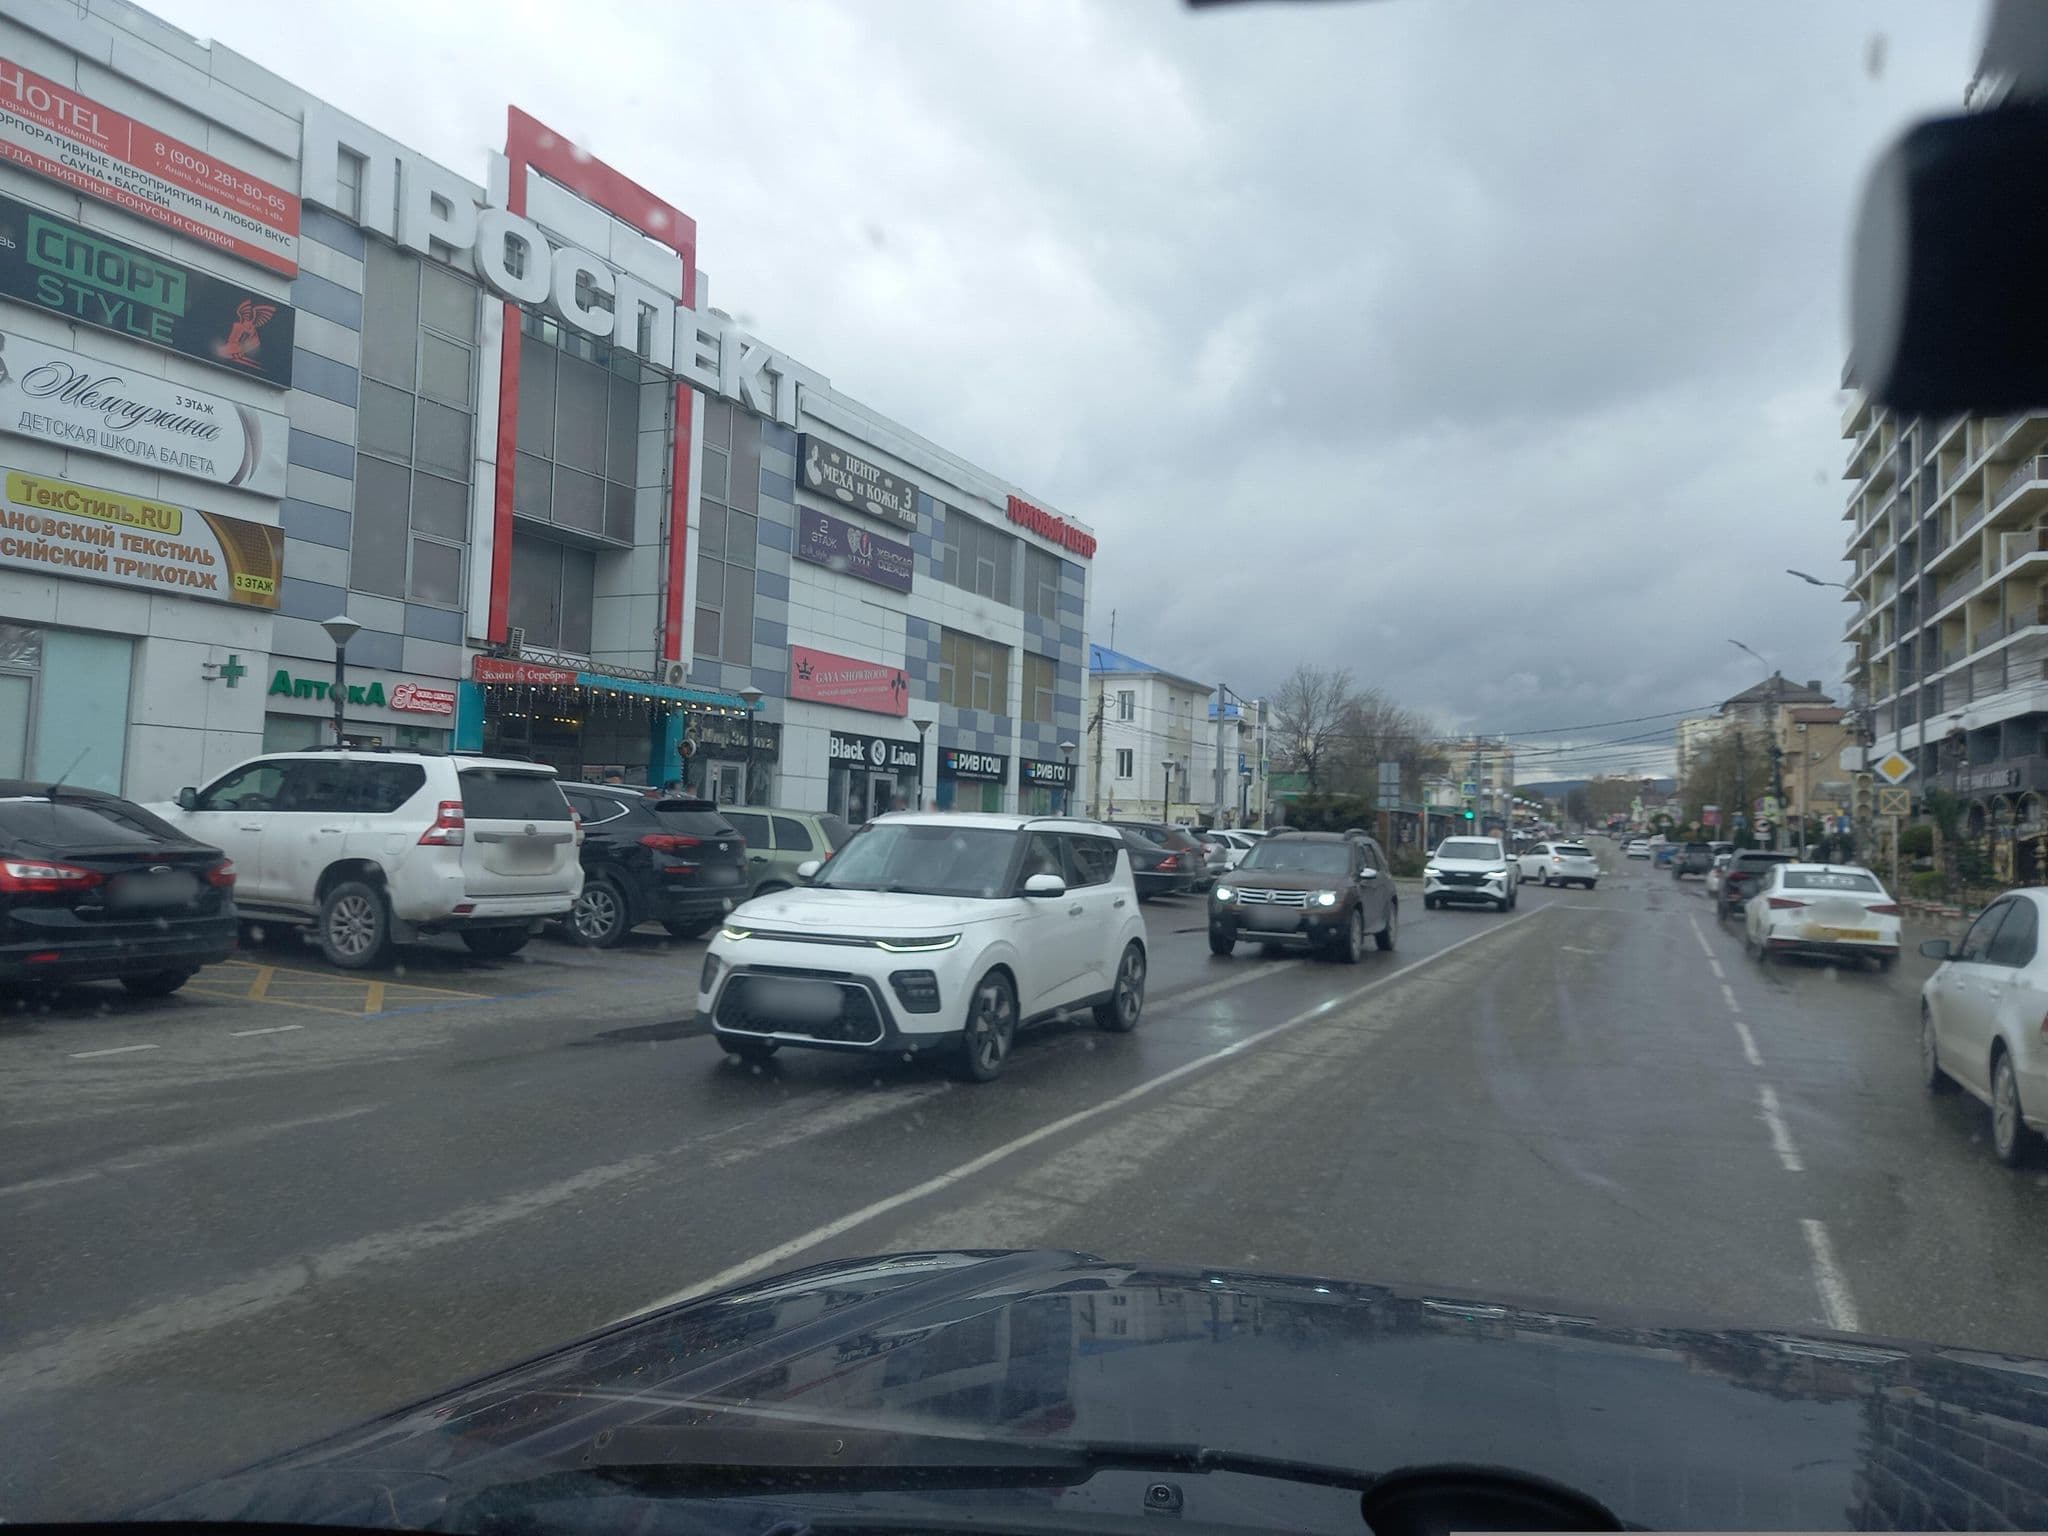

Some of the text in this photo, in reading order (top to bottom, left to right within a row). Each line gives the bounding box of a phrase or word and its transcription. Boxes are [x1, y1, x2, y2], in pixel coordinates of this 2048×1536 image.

[0, 63, 109, 140] HOTEL
[58, 123, 110, 151] комплекс
[60, 154, 170, 207] САУНА БАССЕЙН
[154, 142, 286, 212] 8 (900) 281-80-65
[38, 159, 113, 198] ПРИЯТНЫЕ
[116, 193, 170, 222] БОНУСЫ
[173, 217, 182, 227] И
[184, 220, 235, 249] СКИДКИ!
[112, 162, 202, 208] МЕРОПРИЯТИЯ
[205, 203, 221, 217] НА
[222, 212, 263, 235] ЛЮБОЙ
[264, 229, 292, 247] ВКУС
[36, 228, 179, 303] СПОРТ
[302, 98, 806, 428] ПРОСПЕКТ
[37, 271, 175, 344] STYLE
[175, 395, 214, 415] 3 ЭТАЖ
[18, 411, 215, 475] ДЕТСКАЯ ШКОЛА БАЛЕТА
[846, 455, 881, 484] ЦЕНТР
[823, 463, 854, 491] МЕХА
[866, 482, 898, 511] КОЖИ
[903, 487, 913, 509] 3
[811, 531, 838, 549] ЭТАЖ
[820, 519, 829, 534] 2
[120, 533, 215, 566] ТЕКСТИЛЬ
[113, 556, 218, 590] ТРИКОТАЖ
[236, 576, 274, 592] 3 ЭТАЖ
[482, 670, 567, 681] Золото Серебро
[830, 737, 917, 767] Black Lion
[959, 753, 1001, 773] РИВ ГОШ
